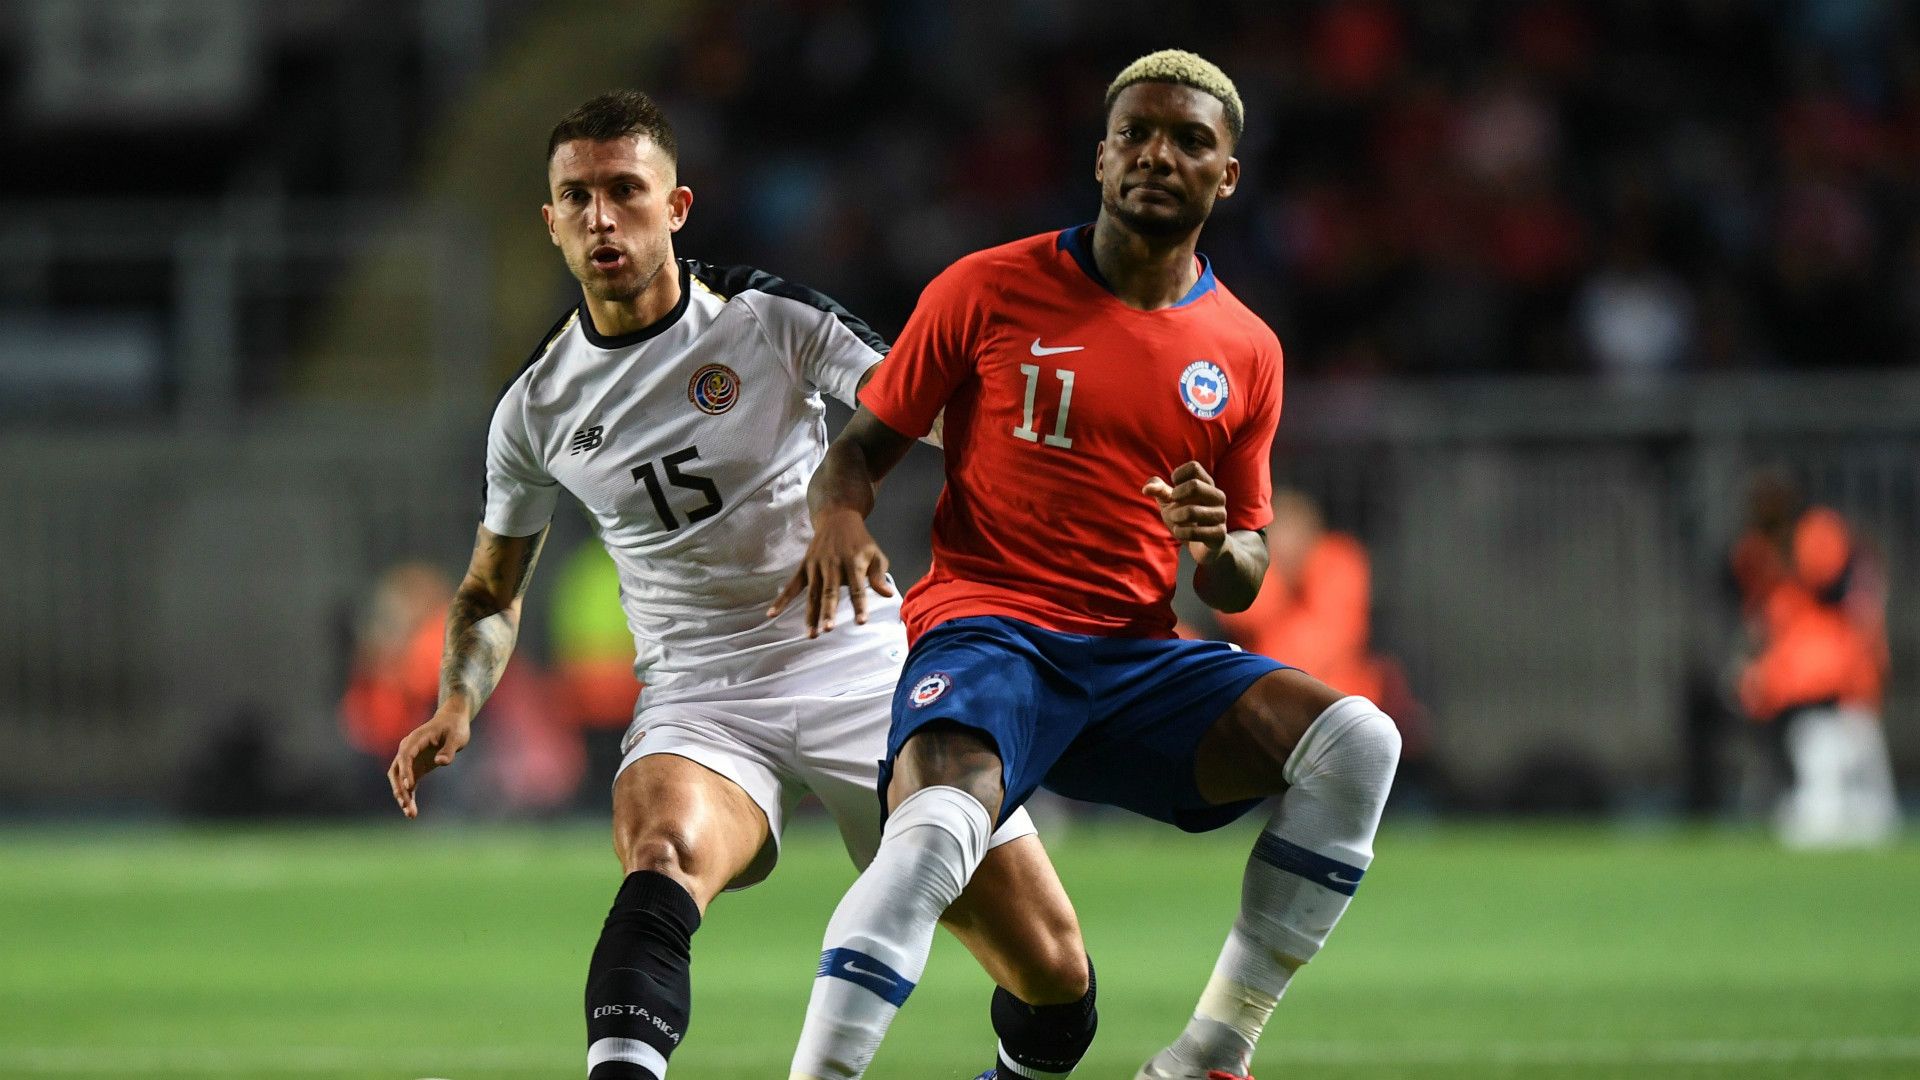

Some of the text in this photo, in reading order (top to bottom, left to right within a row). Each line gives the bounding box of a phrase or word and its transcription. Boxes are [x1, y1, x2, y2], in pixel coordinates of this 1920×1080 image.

[1013, 363, 1075, 449] 11
[631, 445, 723, 532] 15
[593, 1004, 680, 1045] COSTA RICA
